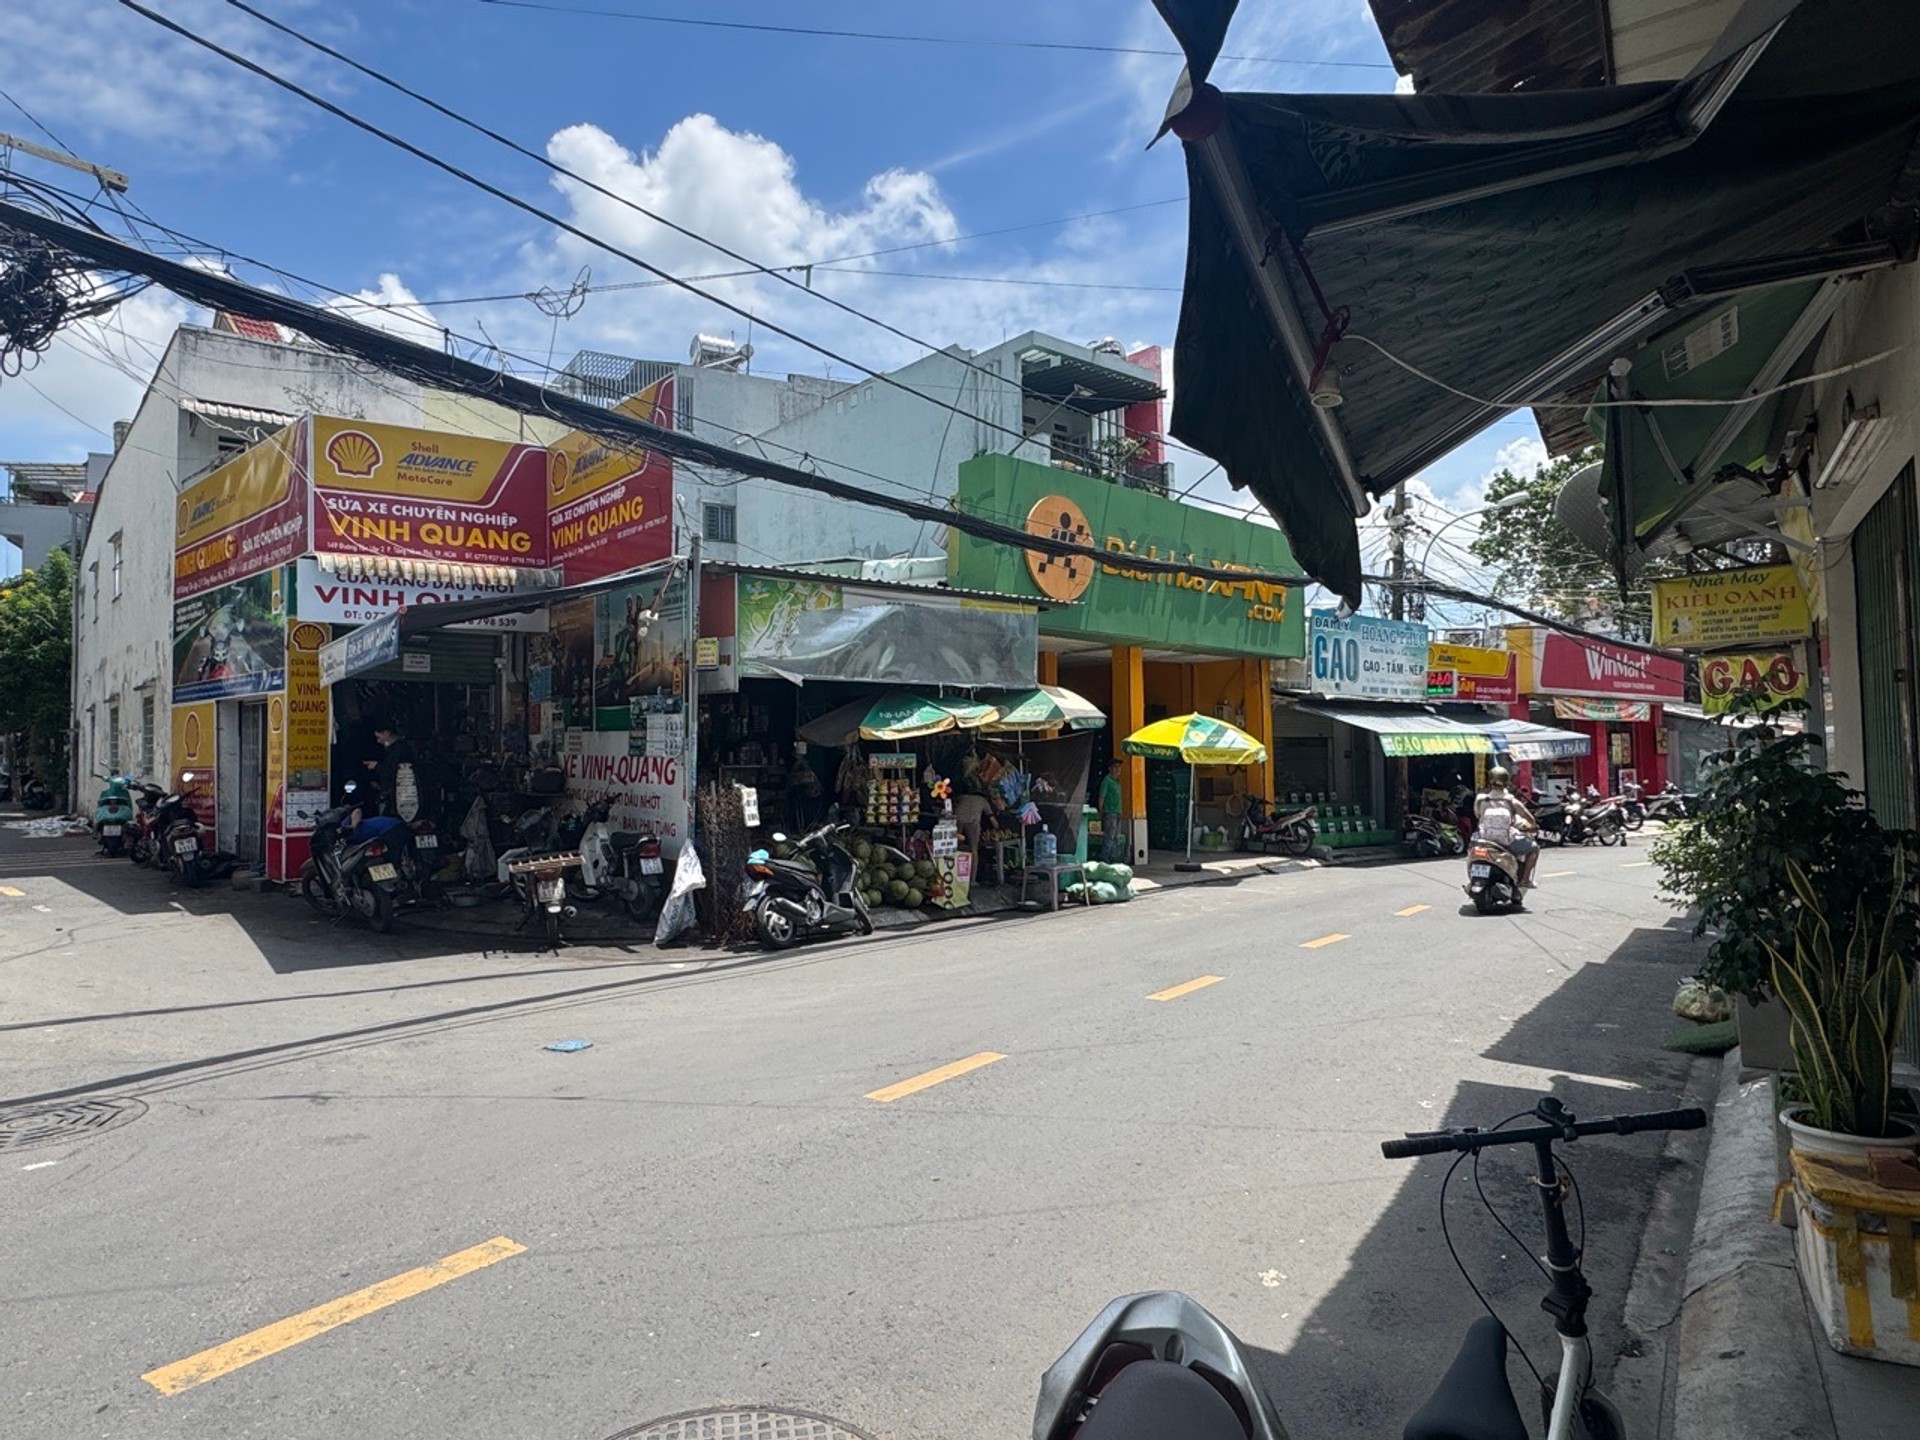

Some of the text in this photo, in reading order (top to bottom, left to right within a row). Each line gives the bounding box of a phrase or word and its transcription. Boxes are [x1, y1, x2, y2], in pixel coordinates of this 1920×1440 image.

[411, 441, 440, 455] Shell
[398, 452, 479, 474] ADVANCE
[396, 471, 454, 488] MotoCare
[326, 495, 519, 530] SỬA XE CHUYÊN NGHIỆP
[327, 513, 534, 552] VINH QUANG
[551, 495, 645, 551] VINH QUANG
[1688, 571, 1771, 589] Nhà May
[314, 585, 402, 608] VINH
[1724, 586, 1797, 606] OANH
[343, 610, 363, 620] ĐT:
[497, 618, 518, 628] 539
[1247, 604, 1285, 624] .COM
[1361, 621, 1397, 644] HOÀNG
[1314, 634, 1360, 691] GẠO
[1363, 659, 1380, 675] GẠO
[1386, 658, 1404, 674] TẤM
[296, 682, 321, 697] VINH
[289, 699, 327, 714] QUANG
[564, 754, 677, 786] XE VINH QUANG
